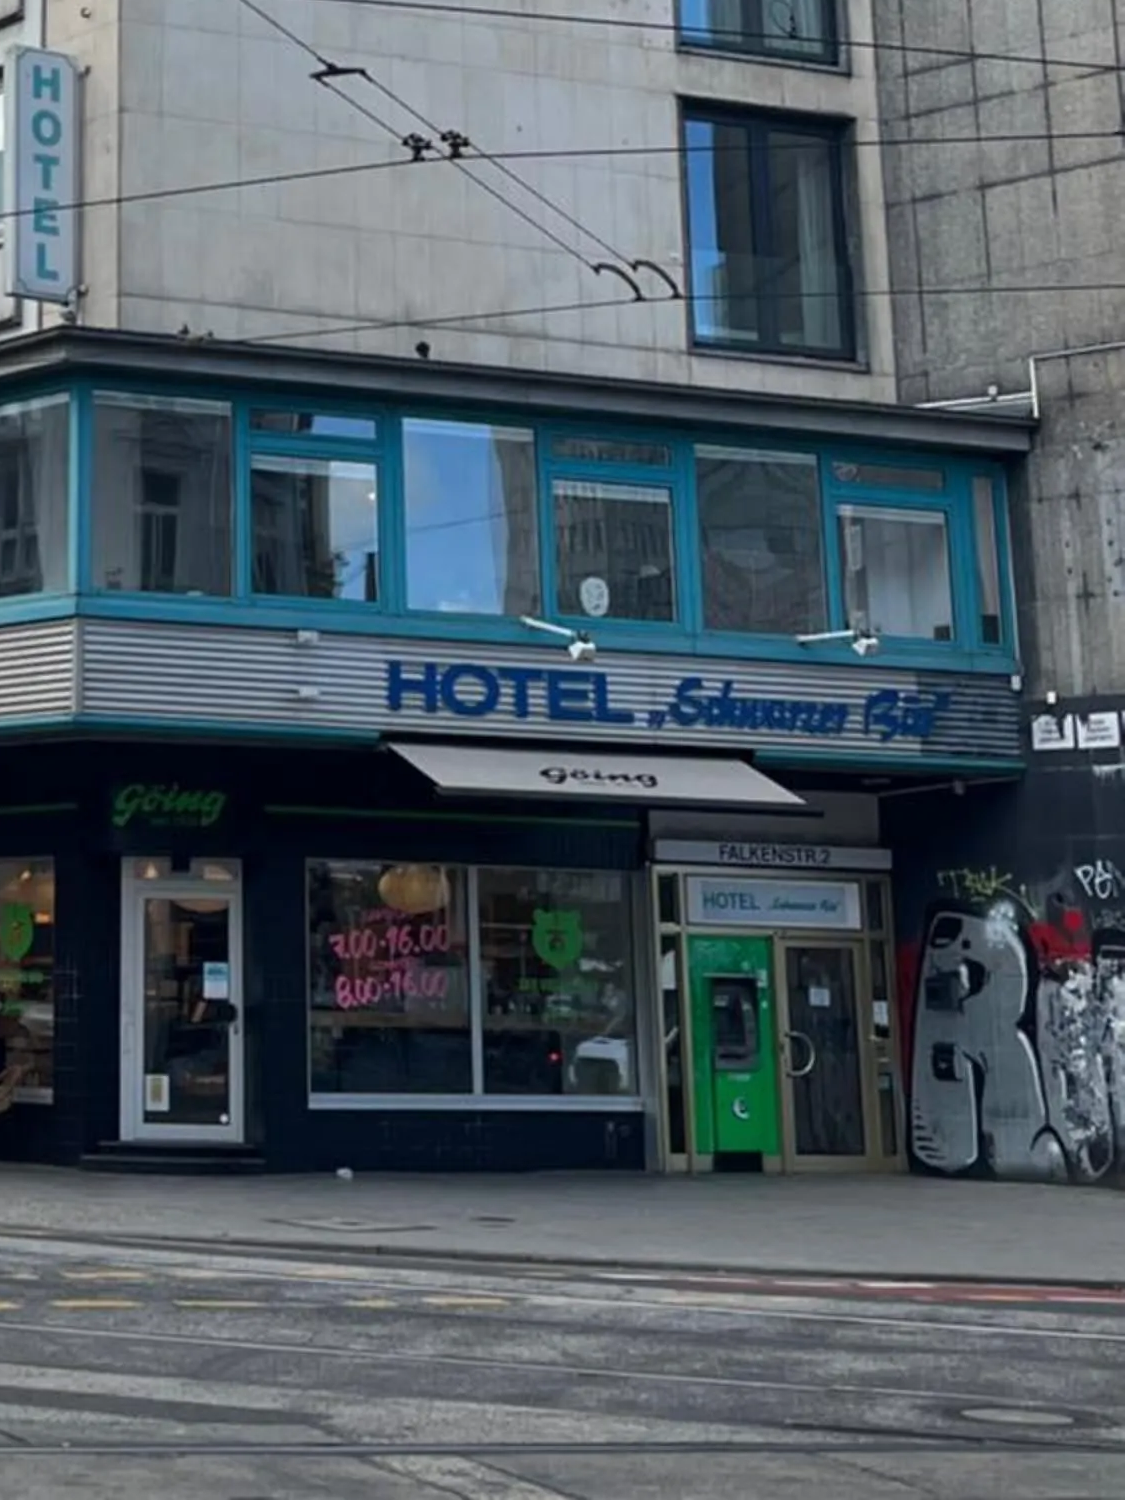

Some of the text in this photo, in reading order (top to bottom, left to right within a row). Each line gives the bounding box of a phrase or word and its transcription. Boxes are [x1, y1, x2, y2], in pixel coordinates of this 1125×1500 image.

[31, 64, 62, 282] HOTEL
[386, 659, 635, 724] HOTEL
[703, 891, 761, 911] HOTEL
